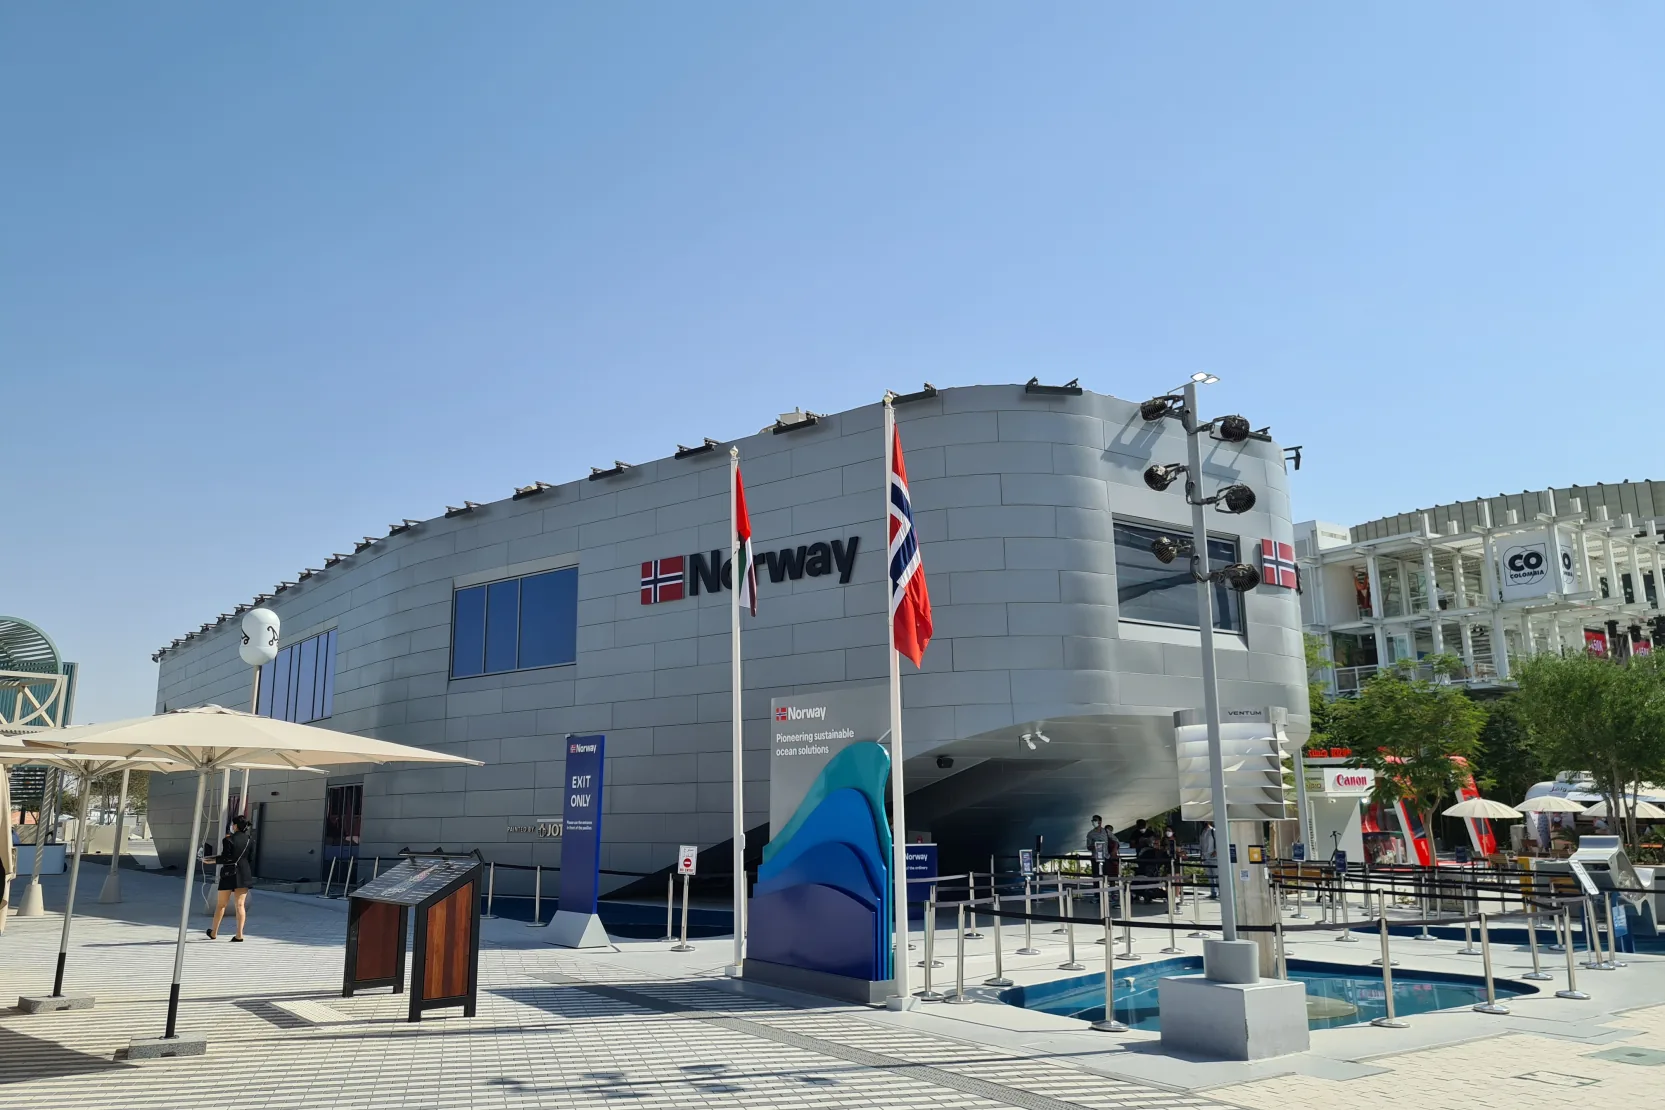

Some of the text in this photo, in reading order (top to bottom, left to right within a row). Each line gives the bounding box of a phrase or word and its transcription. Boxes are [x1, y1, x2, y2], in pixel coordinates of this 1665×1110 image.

[1508, 551, 1543, 572] CO
[1561, 552, 1572, 570] O
[1510, 569, 1545, 579] COLOMBIA
[787, 706, 827, 721] Norway
[776, 728, 855, 743] Pioneering sustainable
[576, 744, 597, 754] Norway
[776, 745, 830, 756] ocean solutions
[572, 776, 591, 788] EXIT
[1336, 773, 1368, 787] Canon
[570, 794, 591, 807] ONLY
[906, 852, 928, 861] Norway
